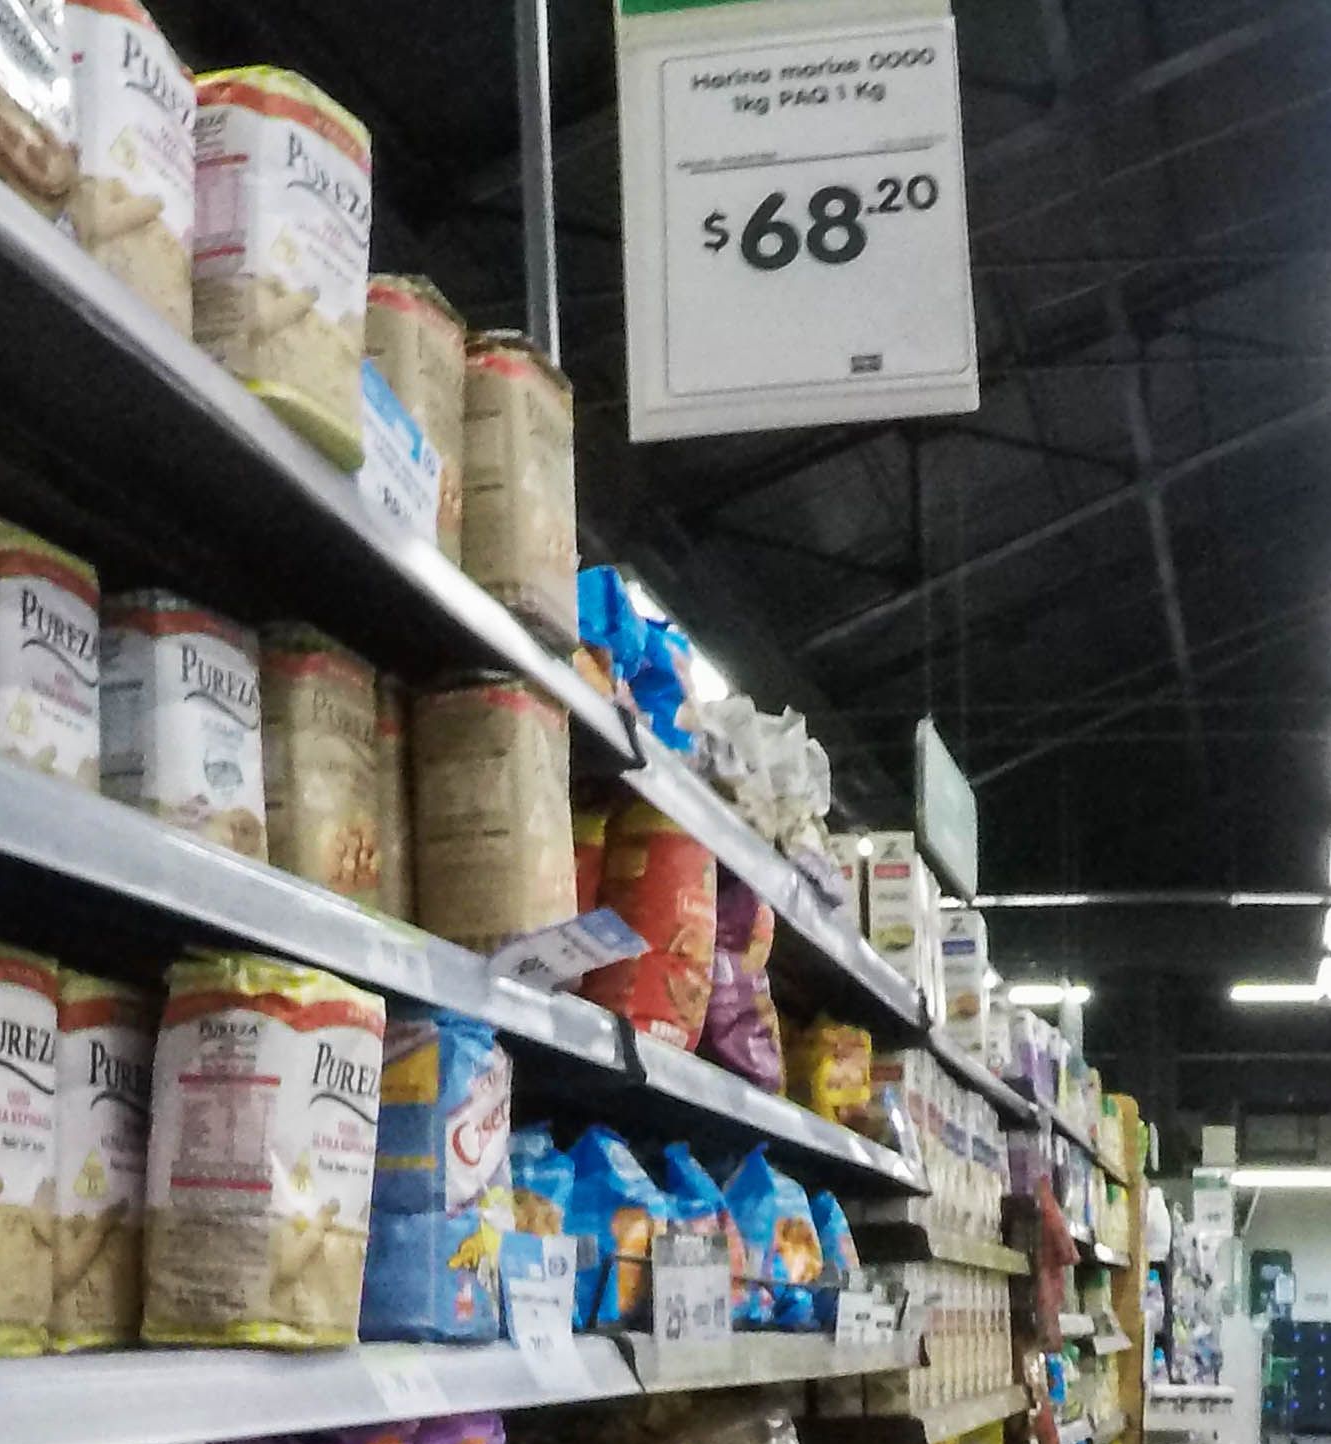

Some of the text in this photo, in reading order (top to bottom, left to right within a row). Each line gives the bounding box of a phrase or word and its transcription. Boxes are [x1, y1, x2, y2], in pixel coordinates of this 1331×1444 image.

[691, 66, 770, 92] Harina
[869, 46, 936, 71] 0000
[778, 88, 830, 109] PAQ
[855, 81, 887, 104] Kg
[312, 1041, 379, 1100] PUREZ
